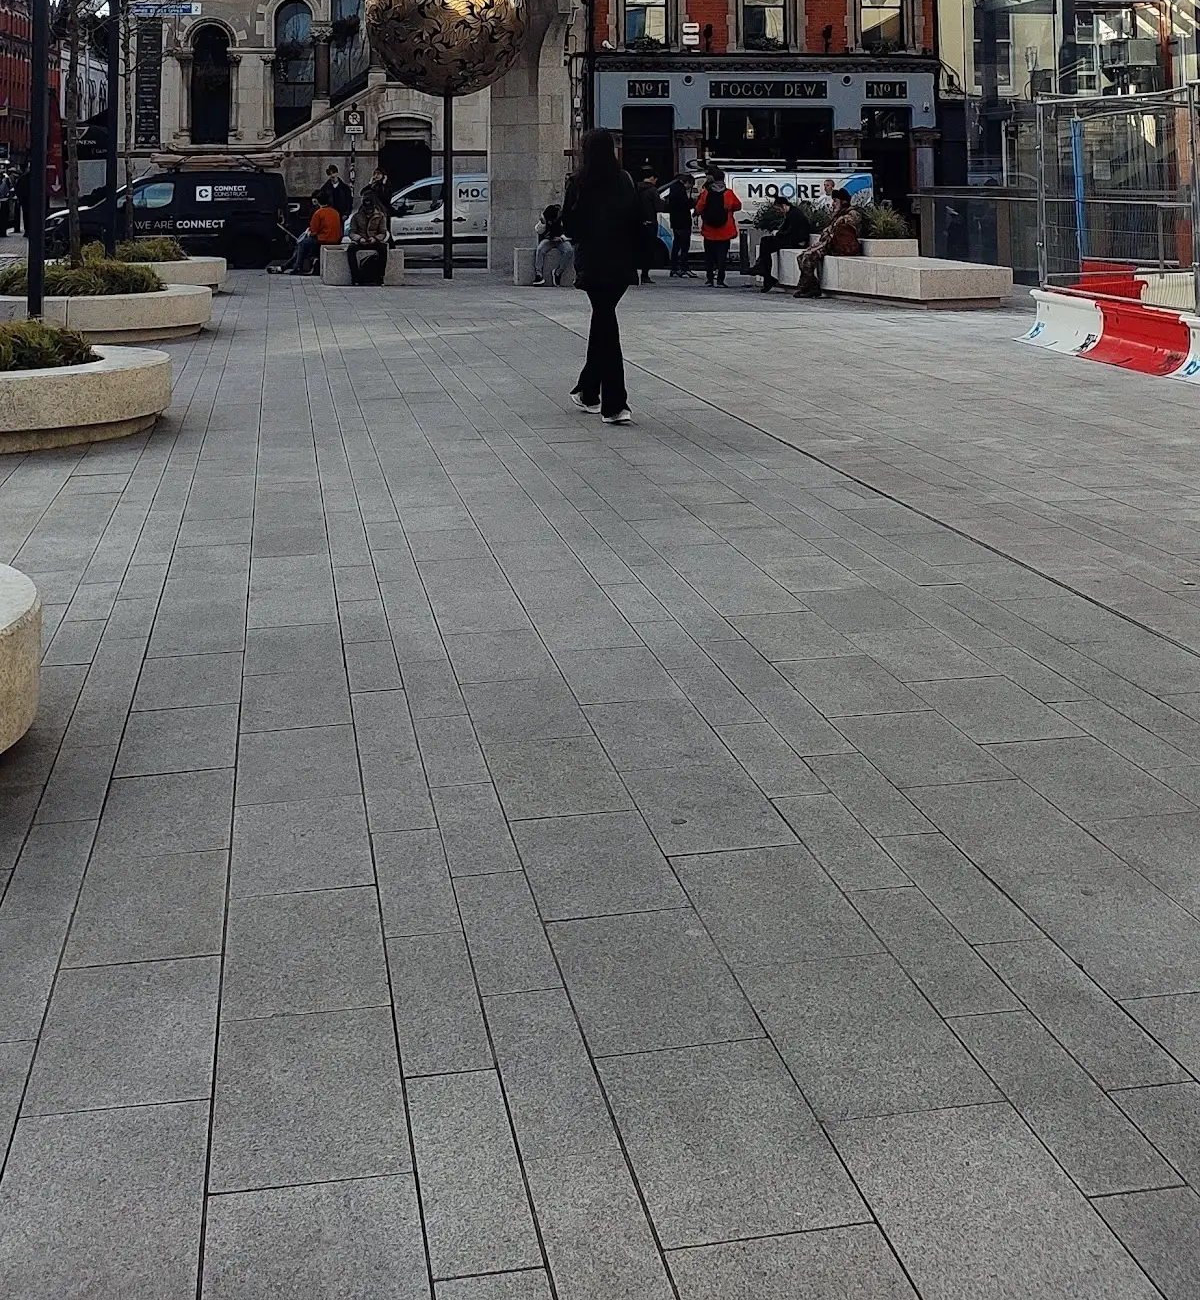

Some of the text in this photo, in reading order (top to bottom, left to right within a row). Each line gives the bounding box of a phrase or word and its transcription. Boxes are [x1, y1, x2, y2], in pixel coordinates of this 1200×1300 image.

[720, 83, 817, 97] FOGGY DEW
[747, 183, 821, 199] MOORE
[134, 219, 226, 230] WE ARE CONNECT
